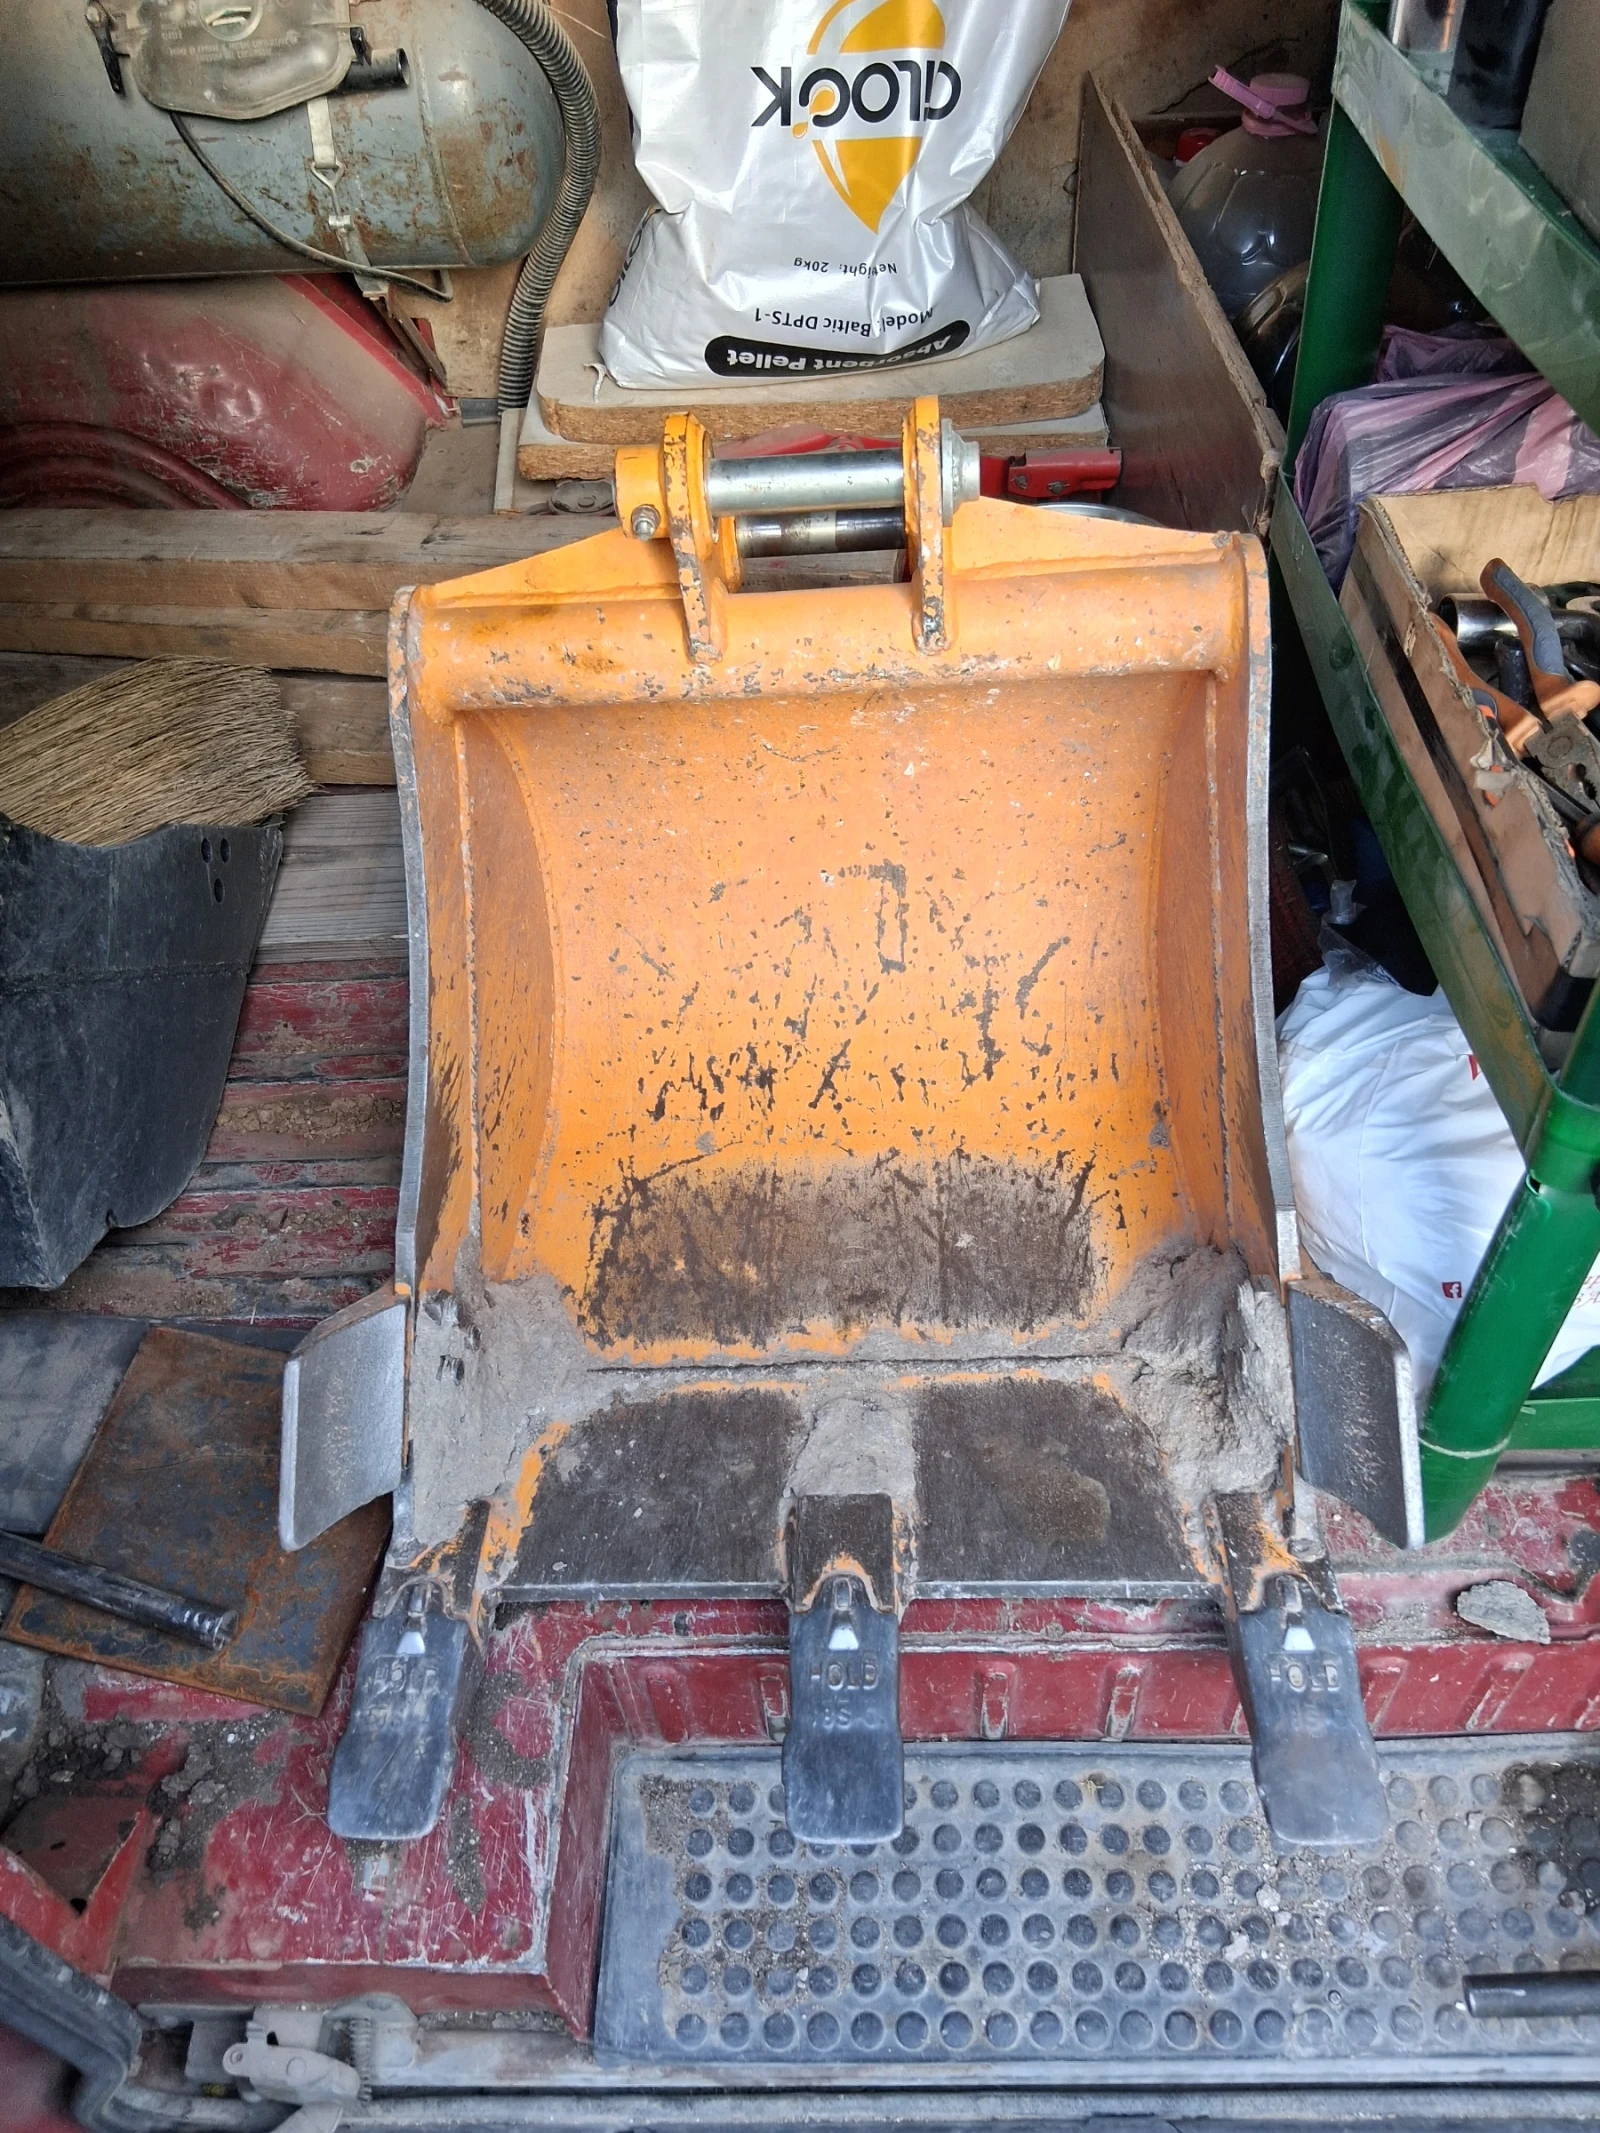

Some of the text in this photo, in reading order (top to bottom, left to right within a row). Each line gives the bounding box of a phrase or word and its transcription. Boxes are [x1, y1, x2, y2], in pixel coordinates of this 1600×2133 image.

[794, 257, 829, 274] 20kg
[754, 307, 818, 330] DPTS-1
[823, 318, 871, 337] Baltic
[727, 334, 952, 371] Absorbent Pellet
